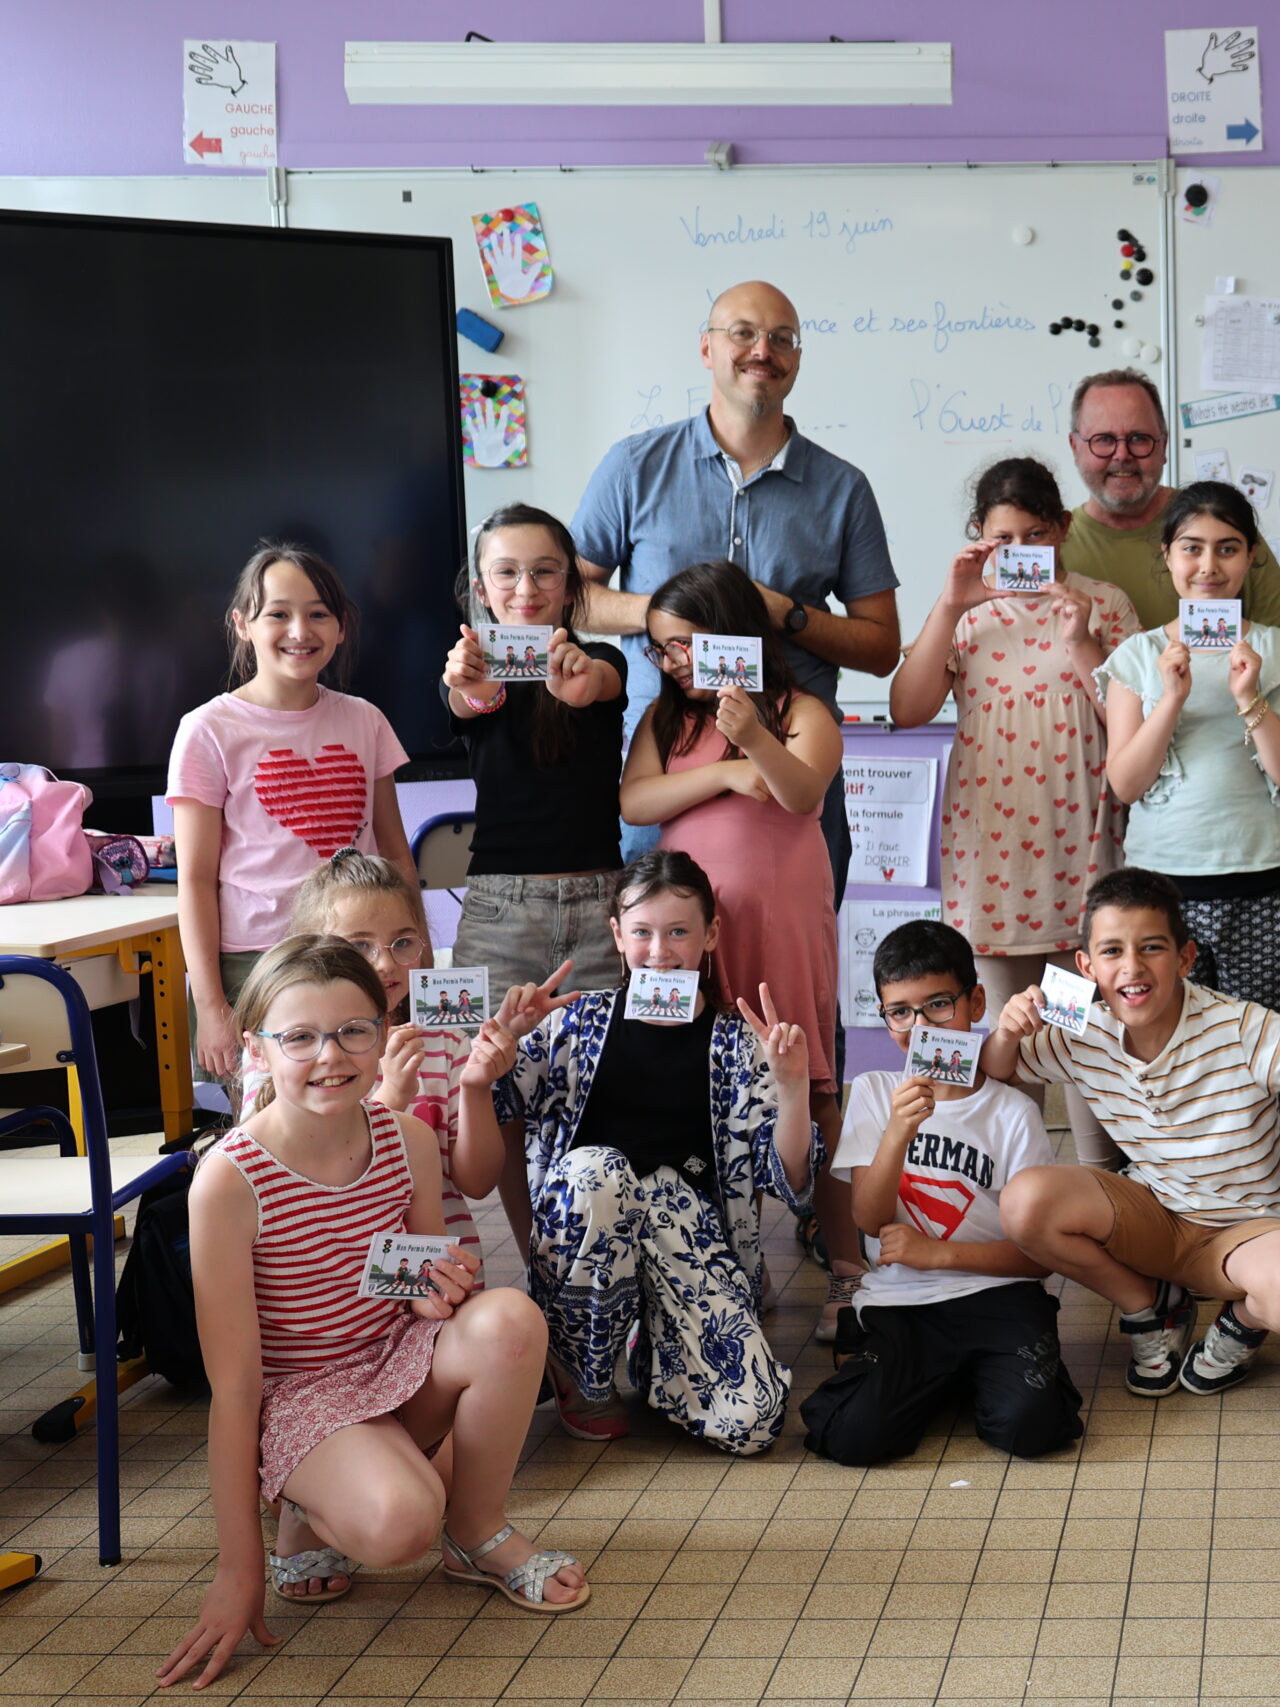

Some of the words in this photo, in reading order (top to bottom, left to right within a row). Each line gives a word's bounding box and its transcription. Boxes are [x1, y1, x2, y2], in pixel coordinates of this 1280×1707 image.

[1171, 91, 1212, 103] DROITE
[225, 103, 274, 115] GAUCHE
[1172, 113, 1207, 124] droite
[230, 124, 275, 138] gauche
[680, 205, 788, 248] Vendredi
[802, 210, 831, 239] 19
[838, 208, 895, 255] juin
[800, 319, 838, 334] nce
[853, 307, 875, 334] et
[889, 317, 927, 333] ses
[933, 301, 1036, 353] frontières
[1020, 411, 1044, 433] de
[843, 768, 865, 778] ent
[868, 767, 912, 779] trouver
[845, 783, 865, 795] itif
[849, 809, 859, 818] la
[862, 810, 904, 820] formule
[878, 841, 900, 852] faut
[864, 855, 910, 867] DORMIR
[872, 908, 885, 917] La
[887, 908, 921, 919] phrase
[924, 908, 941, 918] aff
[907, 1133, 994, 1189] ERMAN
[407, 1244, 424, 1253] Permis
